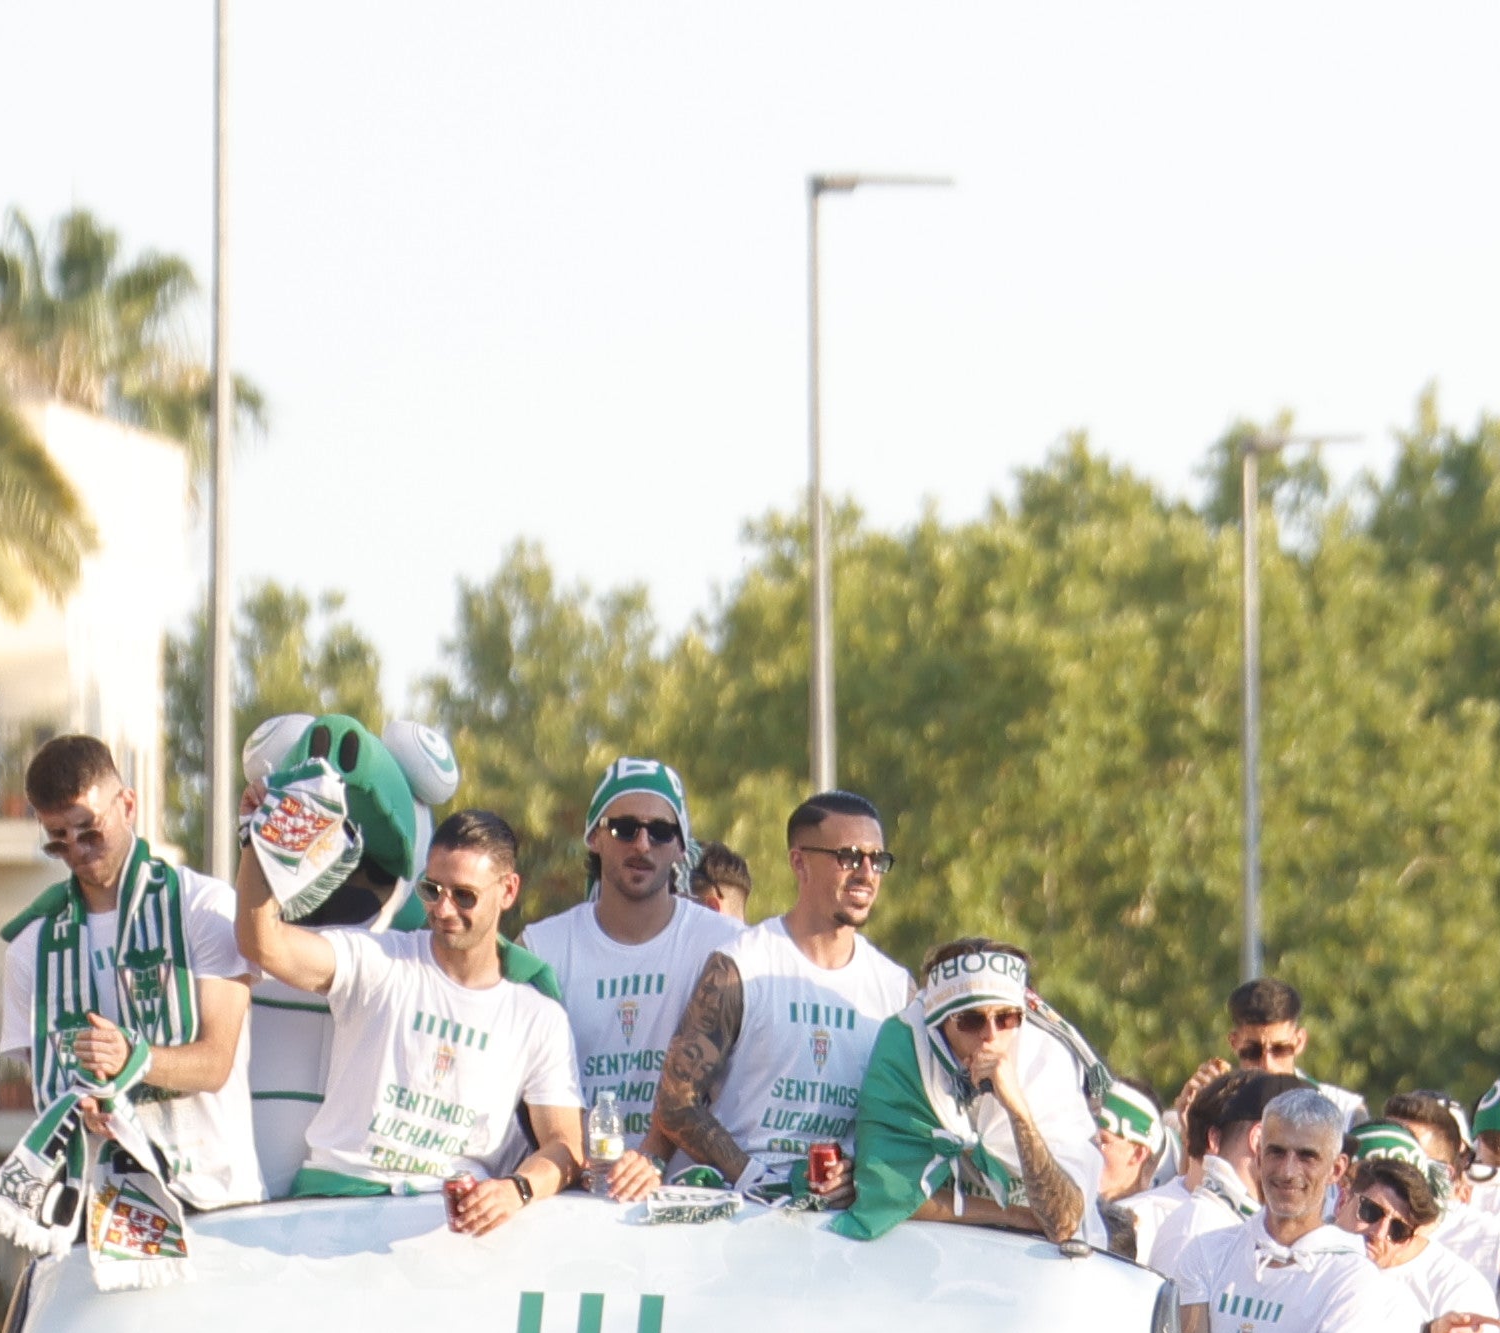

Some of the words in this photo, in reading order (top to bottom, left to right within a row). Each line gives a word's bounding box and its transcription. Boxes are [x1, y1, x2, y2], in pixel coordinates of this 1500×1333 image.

[384, 1083, 477, 1128] SENTIMOS
[770, 1078, 859, 1106] SENTIMOS
[368, 1112, 468, 1156] LUCHAMOS
[761, 1107, 856, 1138] LUCHAMO
